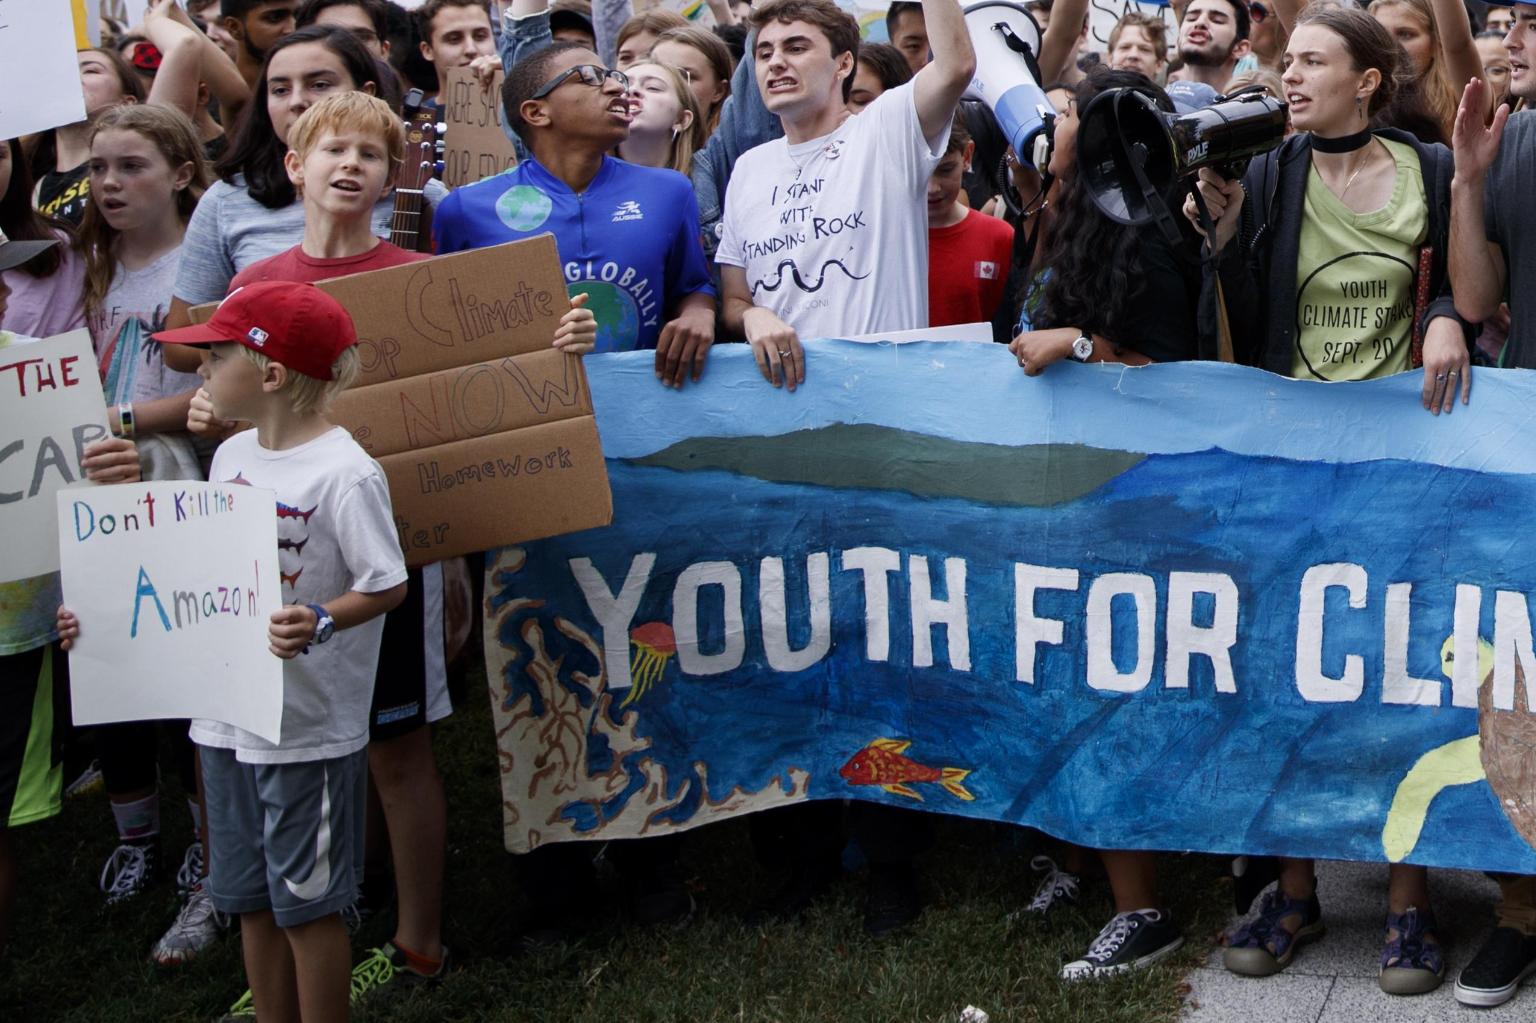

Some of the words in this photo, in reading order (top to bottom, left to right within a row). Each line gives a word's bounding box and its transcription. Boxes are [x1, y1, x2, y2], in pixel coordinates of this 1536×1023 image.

[1188, 141, 1210, 167] PYLE
[813, 211, 866, 239] ROCK
[565, 261, 657, 326] GLOBALLY
[1340, 280, 1387, 299] YOUTH
[1303, 304, 1368, 328] CLIMATE
[1323, 338, 1364, 363] SEPT.
[1373, 337, 1394, 360] 20
[0, 356, 79, 397] THE
[400, 352, 579, 448] NOW
[74, 491, 155, 542] Don't
[174, 490, 208, 522] Kill
[214, 490, 234, 514] the
[131, 560, 260, 639] Amazon!
[568, 546, 972, 689] YOUTH
[1013, 563, 1239, 694] FOR
